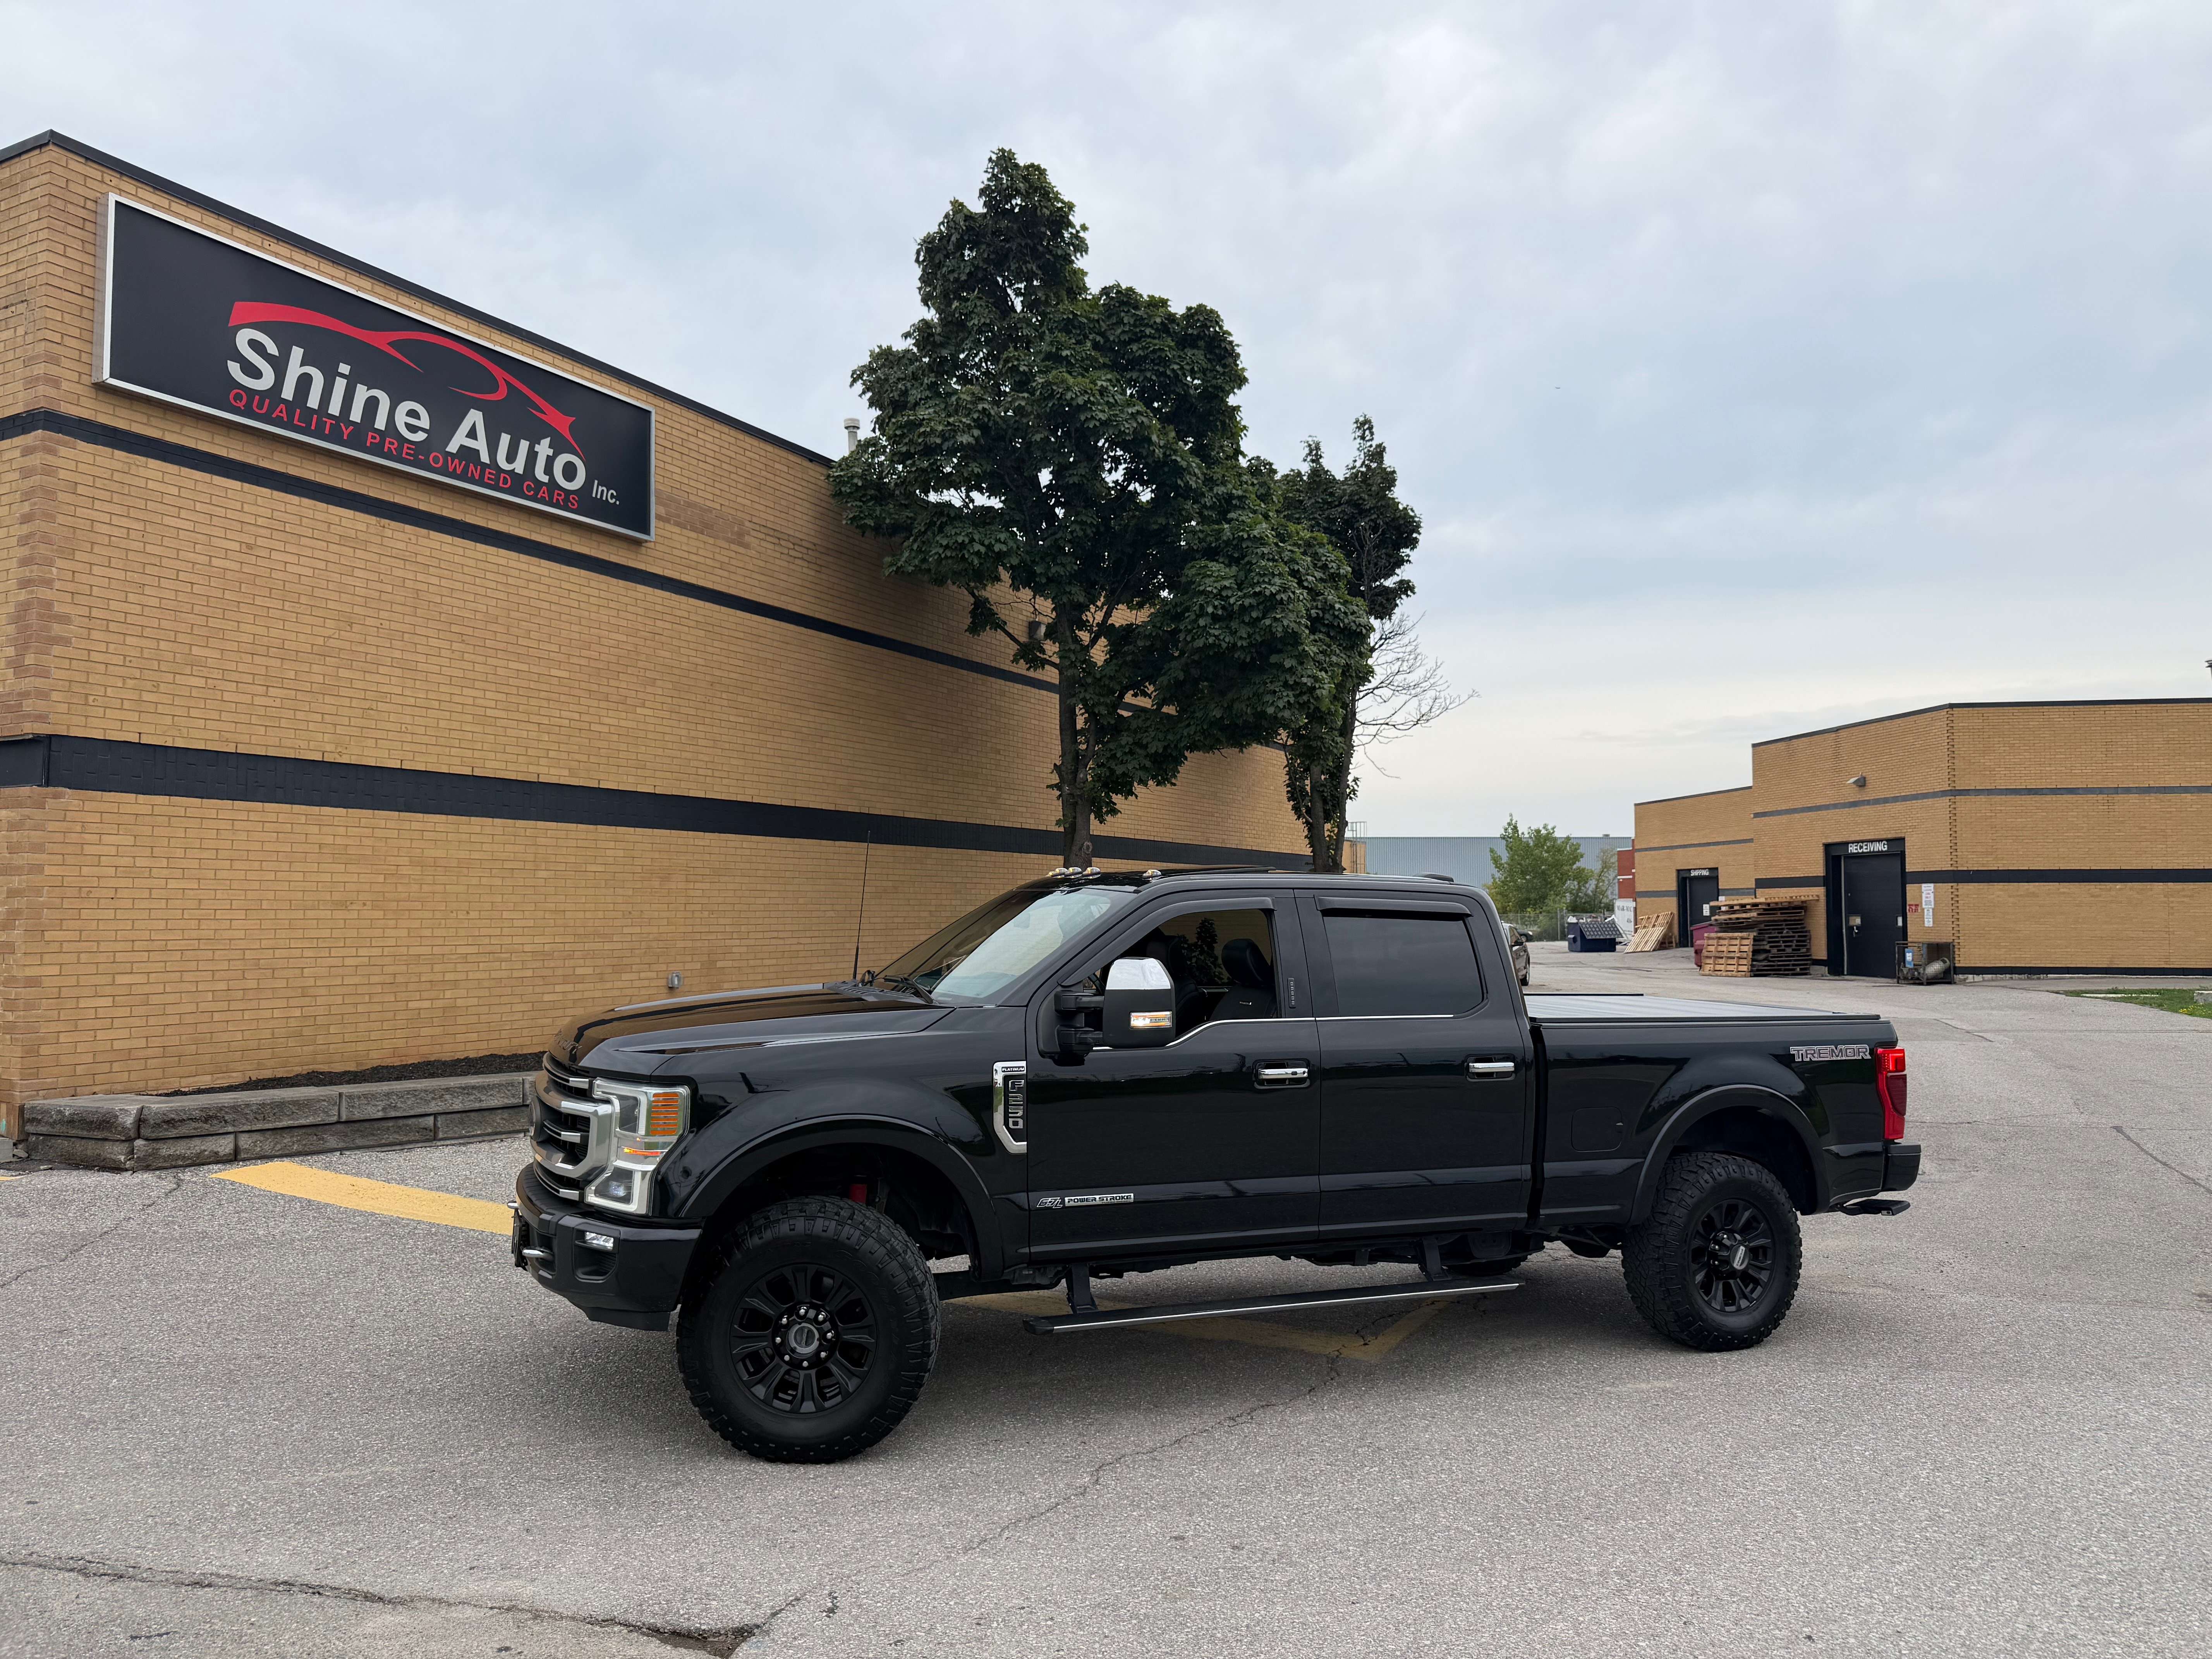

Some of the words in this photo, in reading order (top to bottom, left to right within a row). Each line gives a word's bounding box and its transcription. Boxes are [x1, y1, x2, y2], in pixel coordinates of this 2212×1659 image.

[227, 328, 430, 442] Shine
[445, 409, 586, 491] Auto
[592, 479, 620, 505] Inc.
[229, 389, 354, 440] QUALITY
[366, 432, 512, 488] PRE-OWNED
[523, 481, 579, 509] CARS
[1848, 840, 1887, 853] RECEIVING
[1790, 1044, 1872, 1061] TREMOR
[1008, 1080, 1025, 1129] F250
